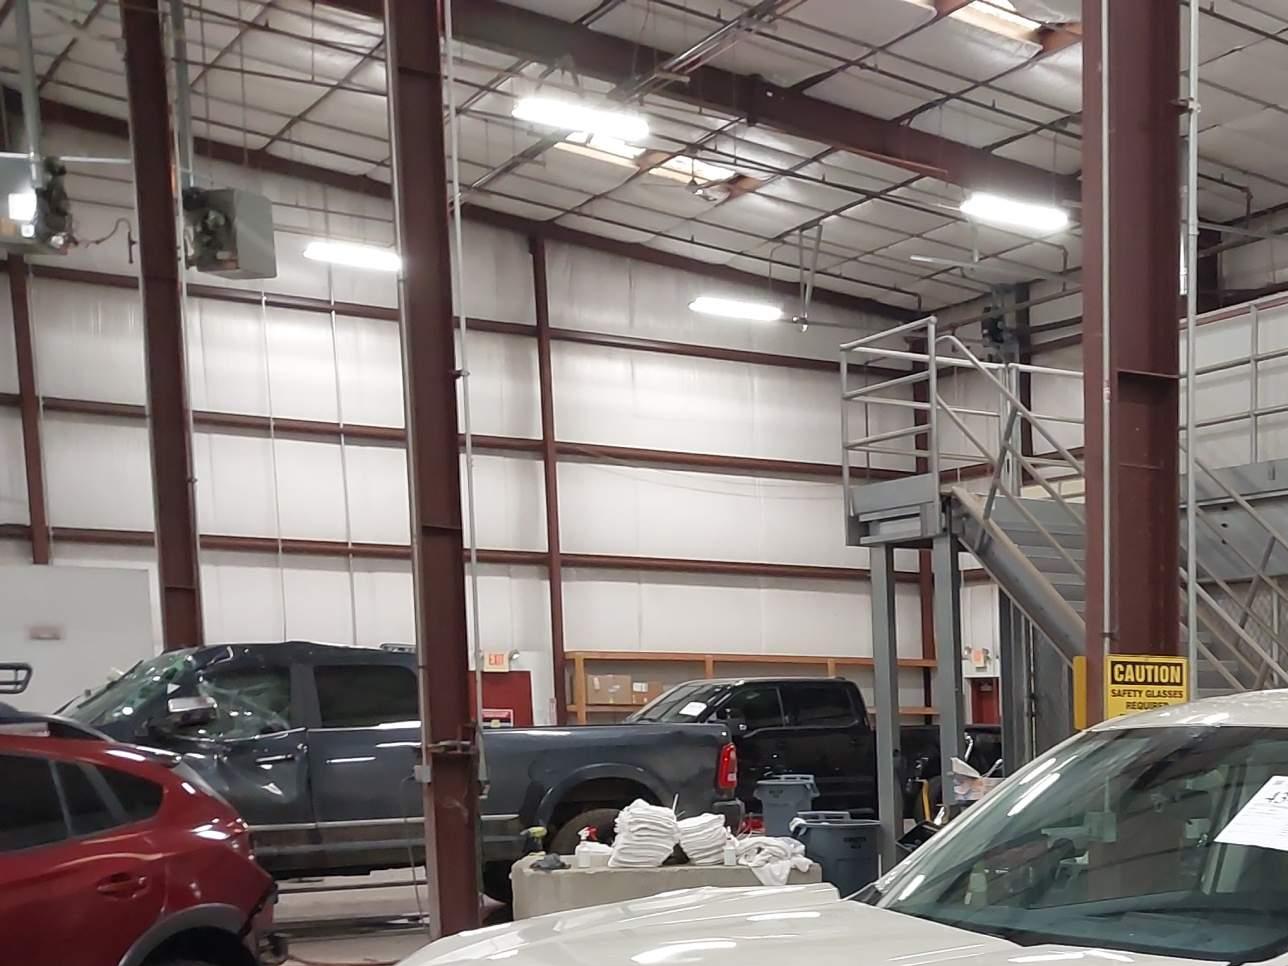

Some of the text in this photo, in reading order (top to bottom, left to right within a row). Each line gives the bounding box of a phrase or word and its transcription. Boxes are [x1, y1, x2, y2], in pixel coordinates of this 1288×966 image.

[1113, 663, 1182, 683] CAUTION
[1111, 688, 1184, 699] SAFETY GLASSES
